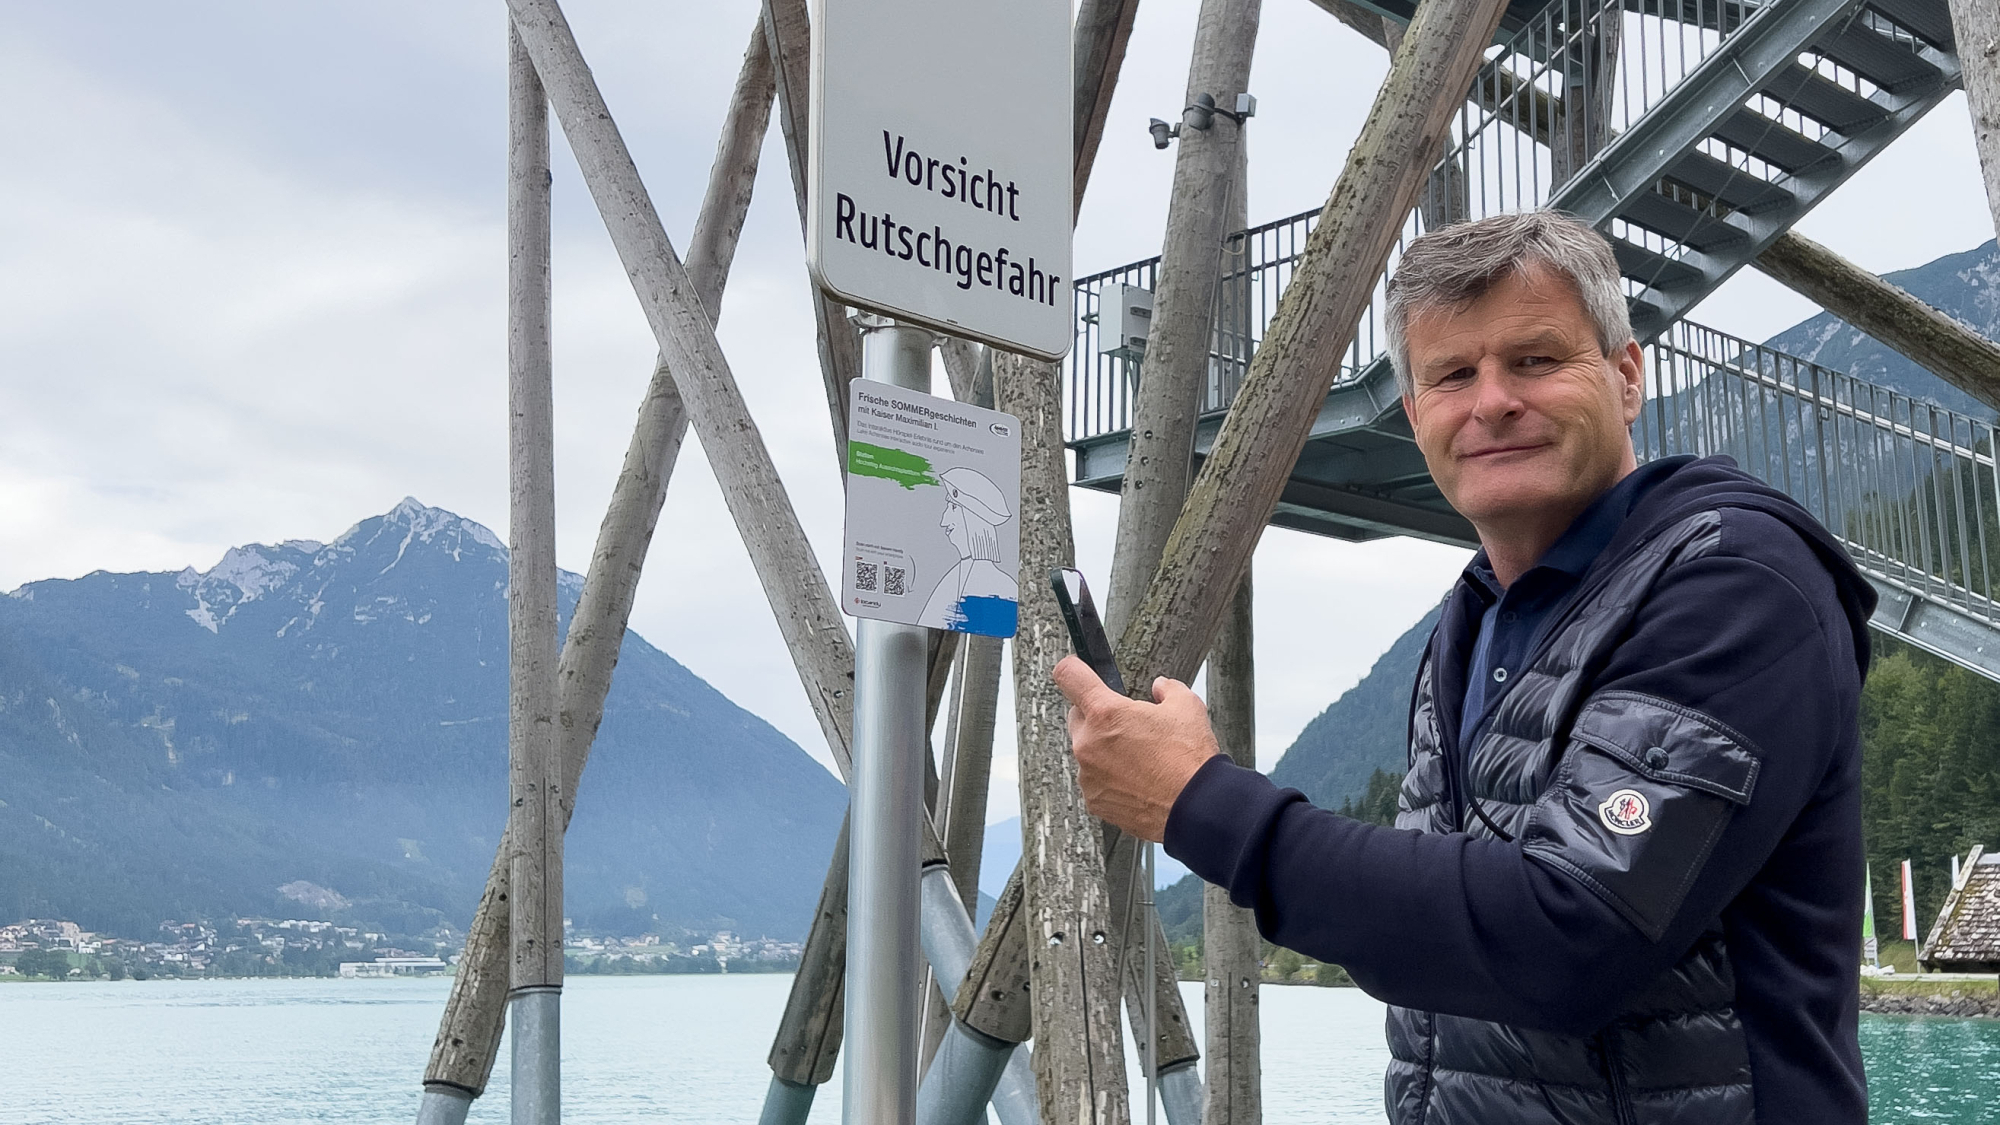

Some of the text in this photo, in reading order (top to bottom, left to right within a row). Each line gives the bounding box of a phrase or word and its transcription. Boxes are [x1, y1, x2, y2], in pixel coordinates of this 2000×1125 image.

[883, 129, 1020, 221] Vorsicht
[836, 192, 1060, 306] Rutschgefahr
[858, 392, 977, 428] Frische SOMMERgeschichten
[858, 405, 870, 415] mit
[871, 407, 894, 421] Kaiser
[895, 413, 932, 429] Maximilian
[1608, 809, 1642, 827] MONCLER
